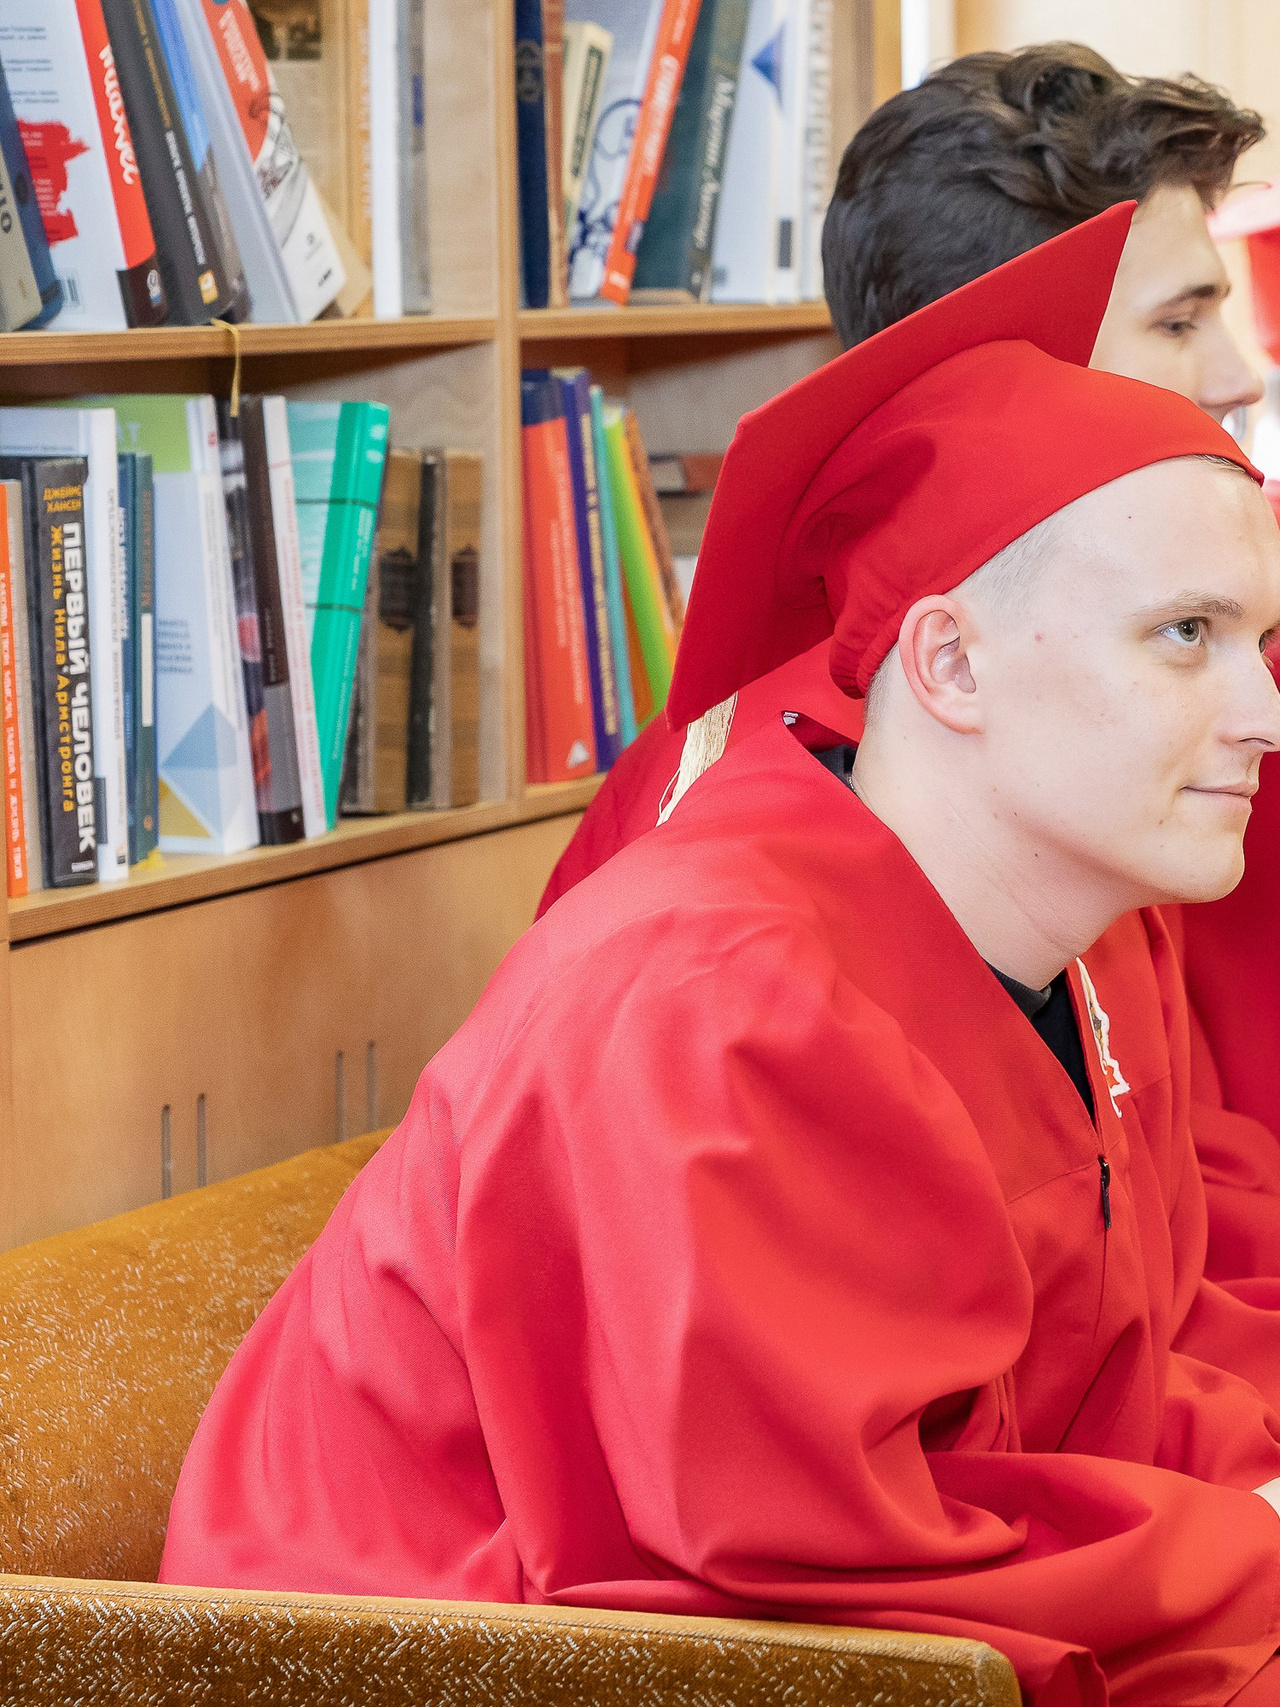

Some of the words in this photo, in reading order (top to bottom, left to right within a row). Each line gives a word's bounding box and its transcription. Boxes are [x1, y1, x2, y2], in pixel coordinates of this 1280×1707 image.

[50, 525, 64, 600] Жизнь
[63, 521, 90, 676] ПЕРВЫЙ
[54, 608, 67, 666] Нила
[55, 674, 75, 812] Армстронга
[71, 681, 96, 853] ЧЕЛОВЕК
